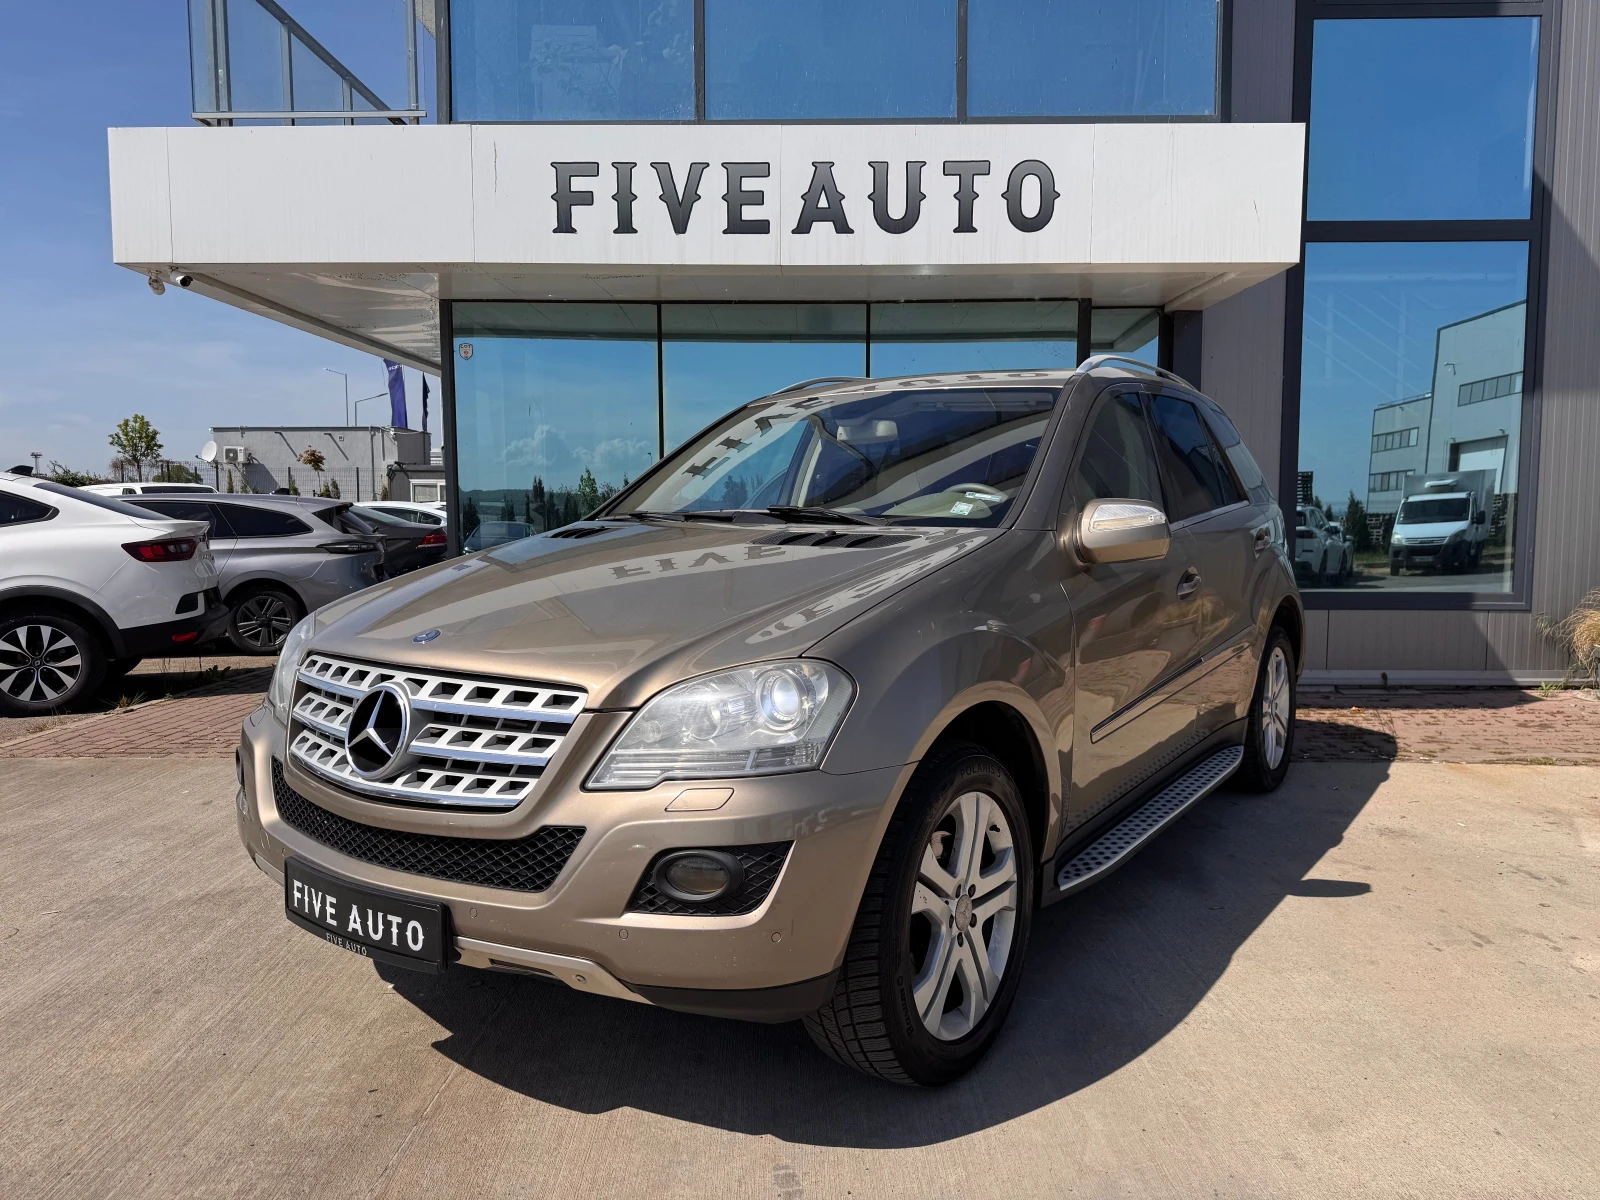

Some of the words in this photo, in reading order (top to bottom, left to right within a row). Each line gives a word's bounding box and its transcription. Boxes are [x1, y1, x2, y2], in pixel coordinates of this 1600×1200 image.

[959, 763, 995, 780] POLARIS
[292, 879, 338, 927] FIVE
[347, 903, 425, 952] AUTO
[326, 932, 343, 947] FIVE
[345, 941, 367, 956] AUTO
